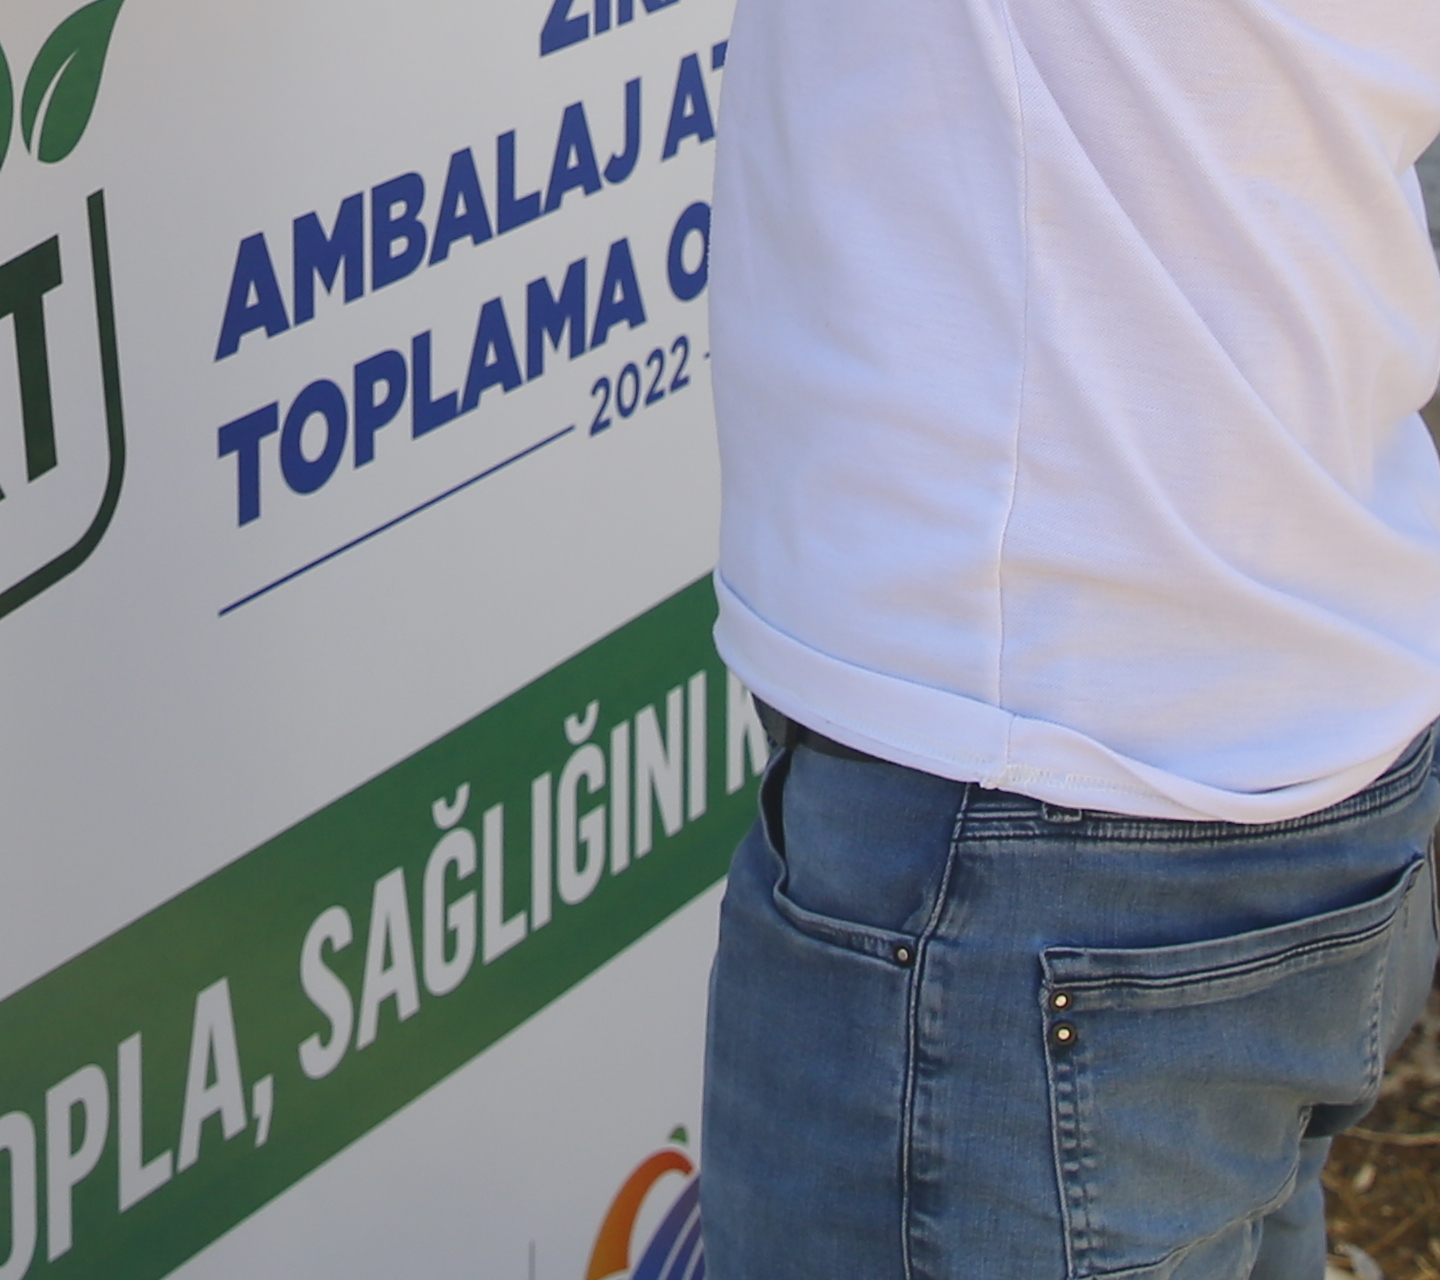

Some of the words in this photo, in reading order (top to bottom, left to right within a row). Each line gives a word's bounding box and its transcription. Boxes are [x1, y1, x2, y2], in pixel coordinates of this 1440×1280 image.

[214, 76, 643, 363] AMBALAJ
[660, 39, 729, 163] A
[216, 237, 647, 529] TOPLAMA
[588, 334, 691, 437] 2022
[298, 669, 708, 1079] SAĞLIĞINI
